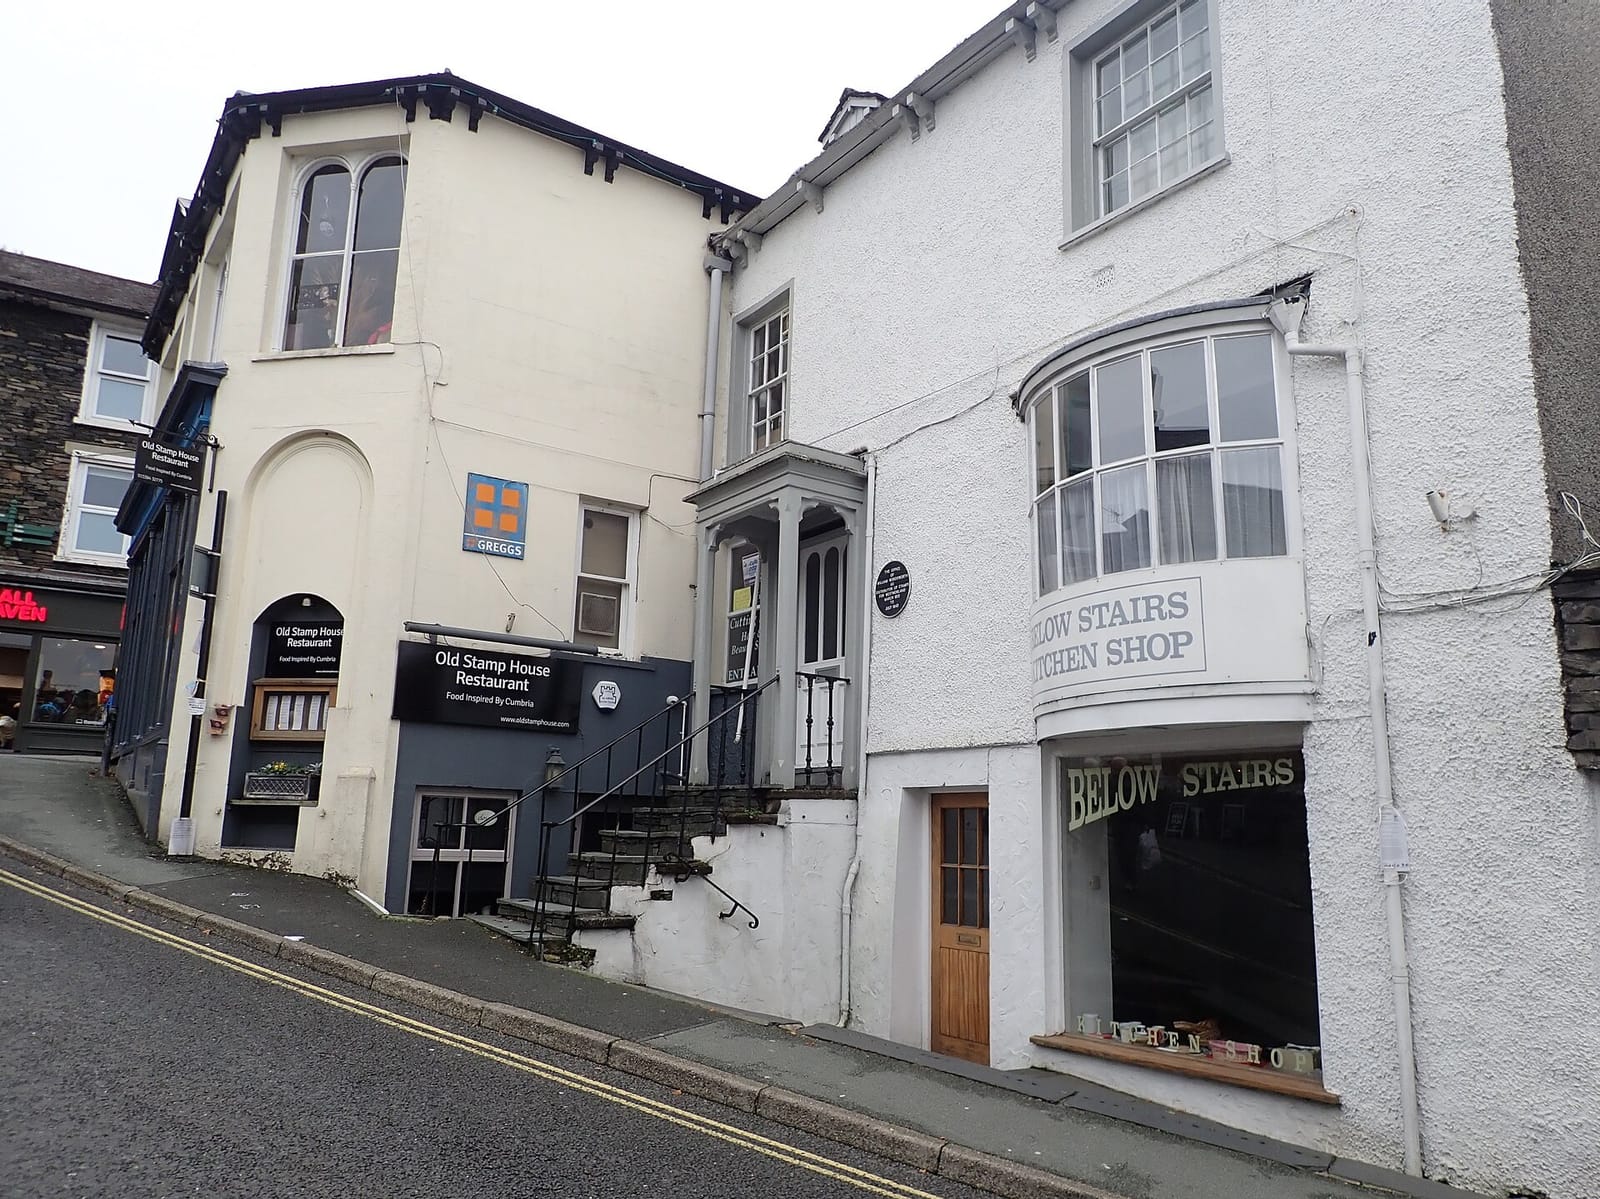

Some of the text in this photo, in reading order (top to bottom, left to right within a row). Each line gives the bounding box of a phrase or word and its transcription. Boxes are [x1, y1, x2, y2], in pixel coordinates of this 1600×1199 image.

[142, 440, 200, 463] Old Stamp House
[151, 451, 189, 468] Restaurant
[477, 540, 522, 556] GREGGS
[1032, 591, 1189, 649] ELOW STAIRS
[275, 626, 344, 639] Old Stamp House
[287, 637, 332, 648] Restaurant
[291, 655, 310, 663] Inspired
[309, 655, 316, 664] By
[316, 655, 336, 663] Cumbria
[435, 651, 551, 677] Old Stamp House
[1032, 630, 1194, 685] ITCHEN SHOP
[456, 670, 530, 692] Restaurant
[446, 691, 535, 708] Food Inspired By Cumbria
[500, 716, 570, 728] www.oldstamphouse.com
[1067, 758, 1295, 832] BELOW STAIRS
[1076, 1015, 1307, 1073] KITCHEN SHOP
